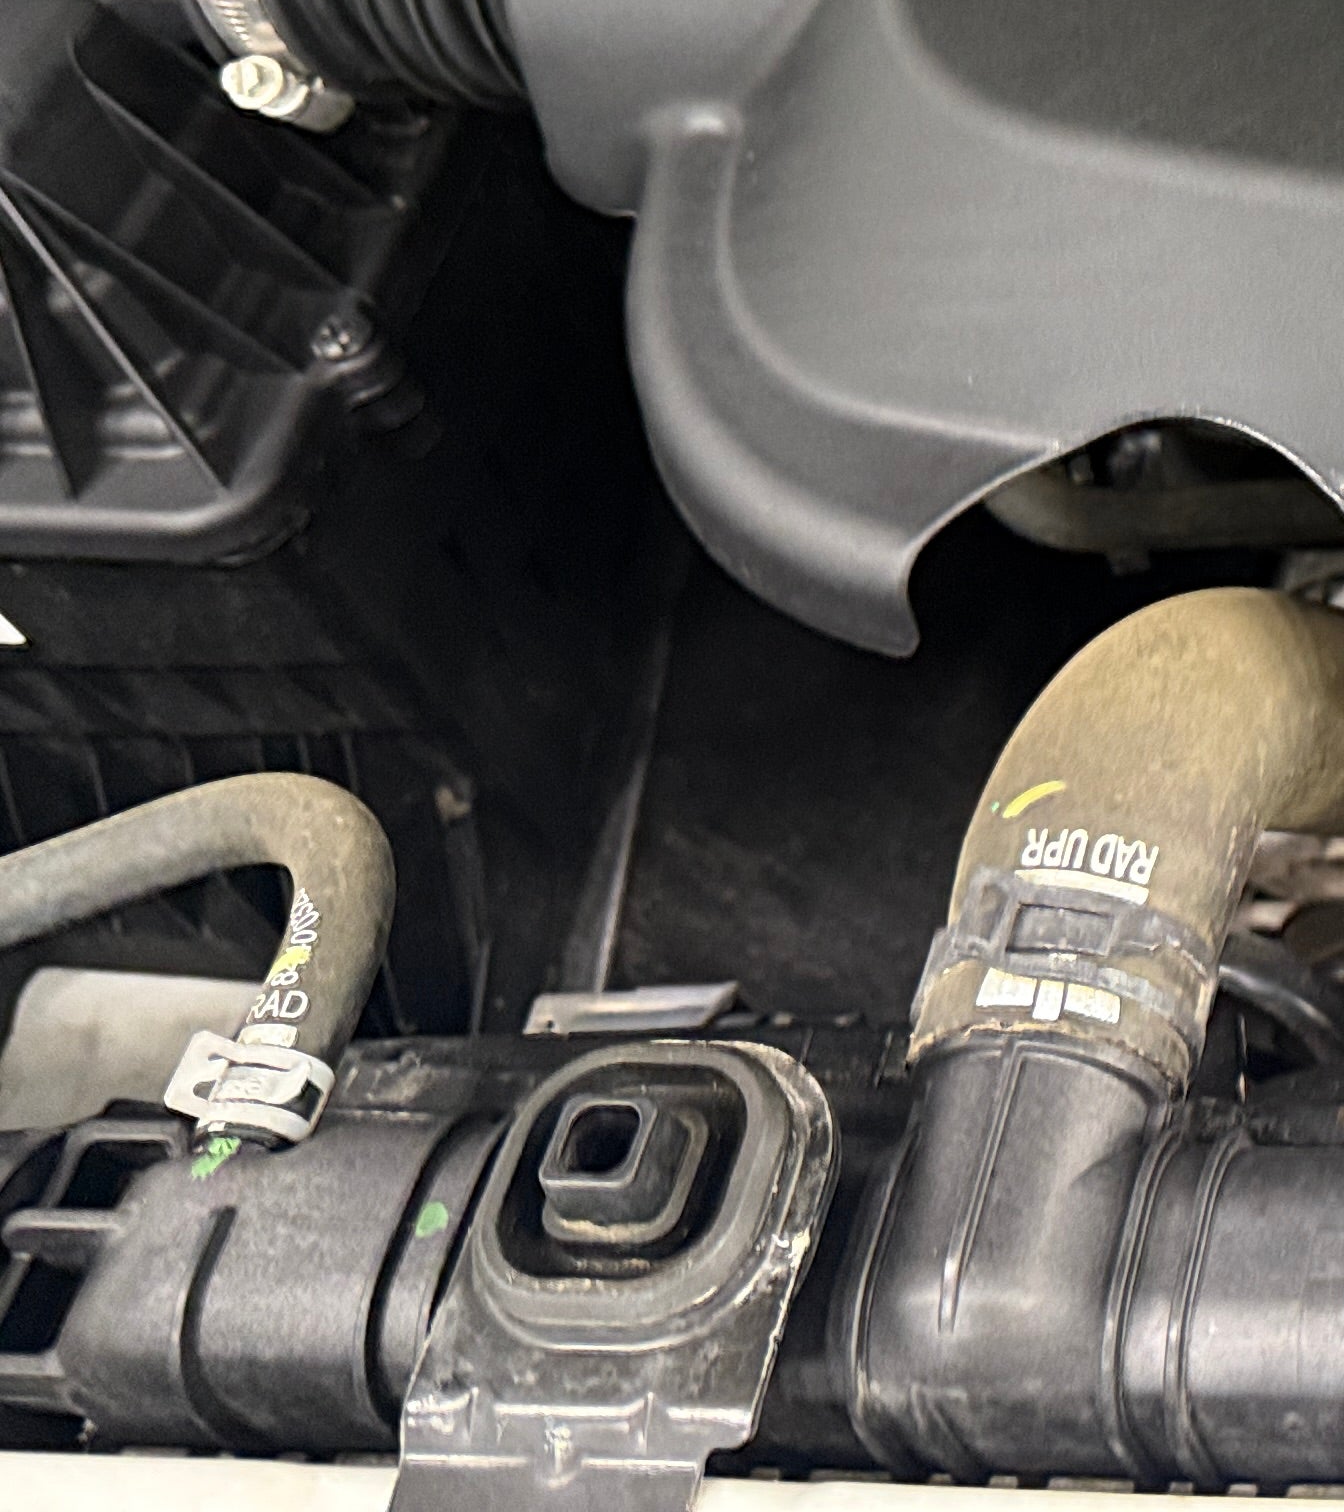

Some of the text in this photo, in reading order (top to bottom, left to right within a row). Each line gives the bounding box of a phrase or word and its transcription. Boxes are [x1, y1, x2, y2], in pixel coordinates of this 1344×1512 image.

[1020, 828, 1159, 885] RAD UPR
[246, 989, 309, 1024] RAD
